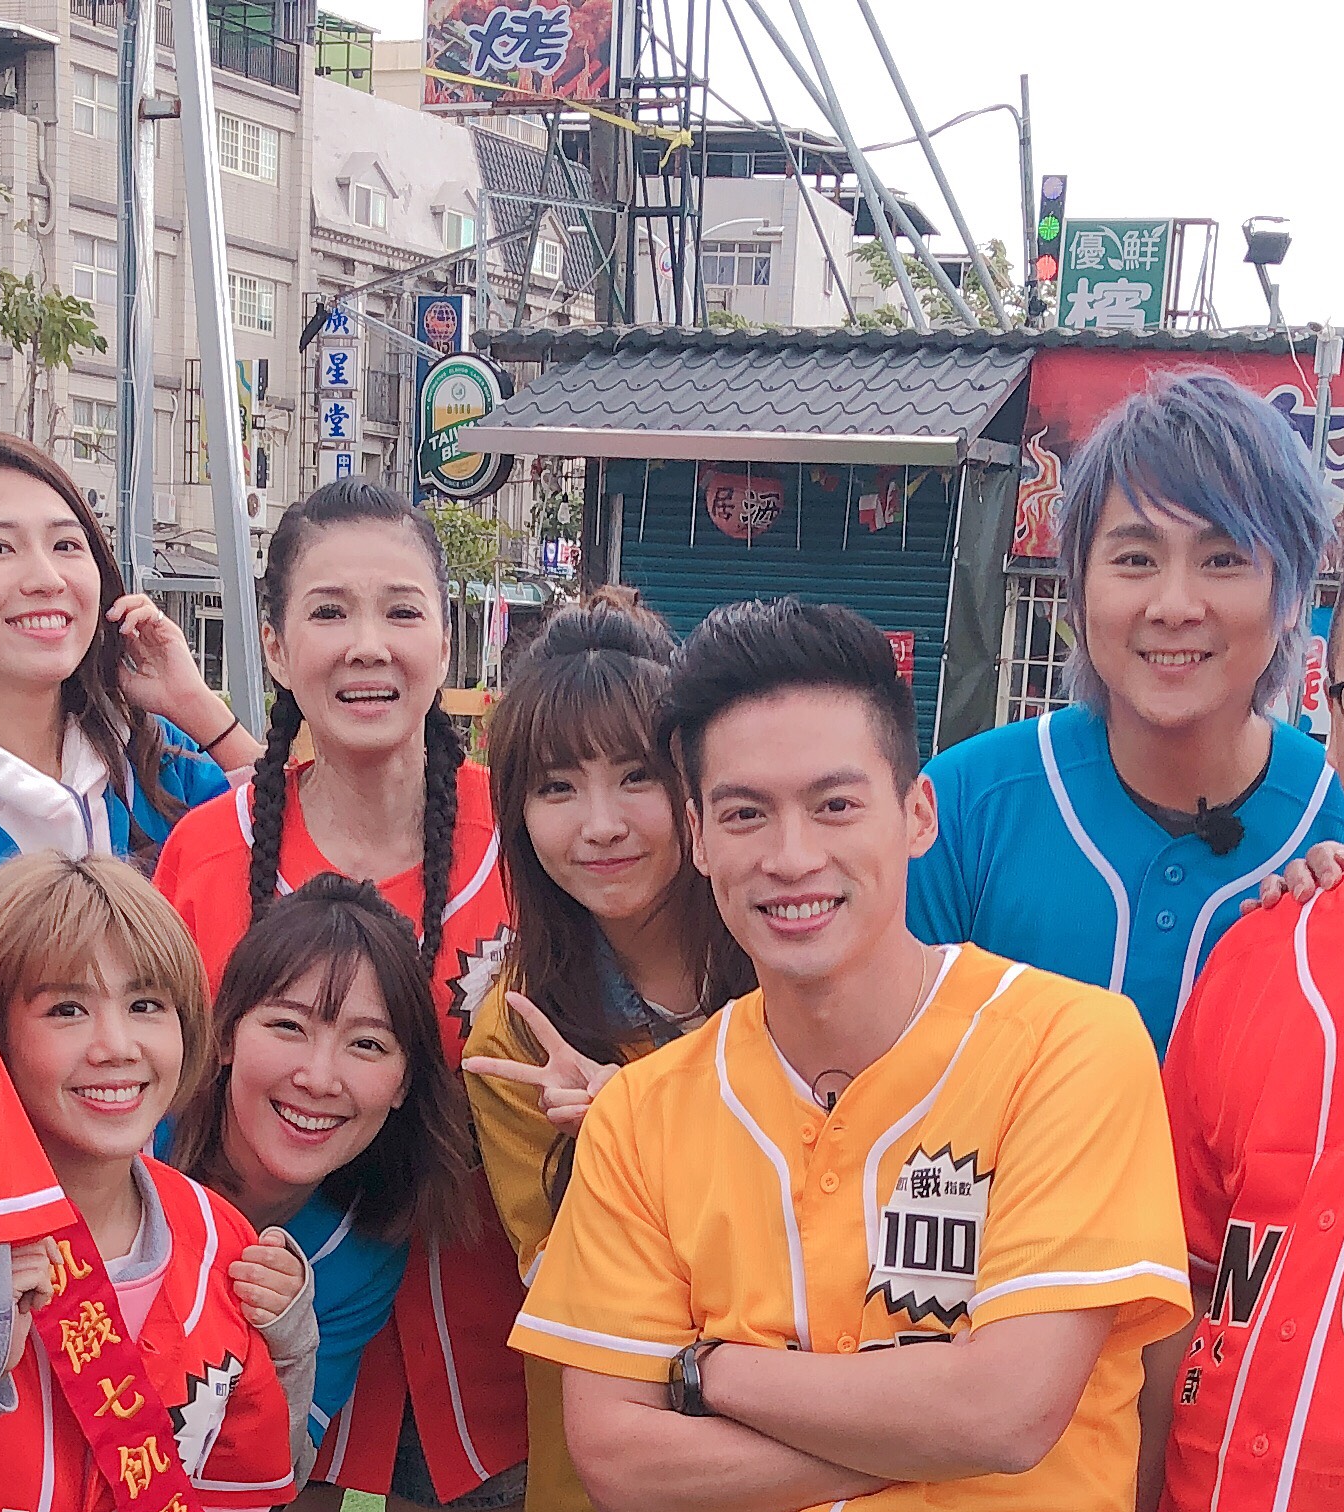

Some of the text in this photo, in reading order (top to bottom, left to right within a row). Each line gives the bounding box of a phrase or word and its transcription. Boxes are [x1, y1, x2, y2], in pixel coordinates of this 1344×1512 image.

[467, 6, 572, 75] 烤
[1069, 228, 1162, 270] 優鮮
[884, 1210, 977, 1276] 100
